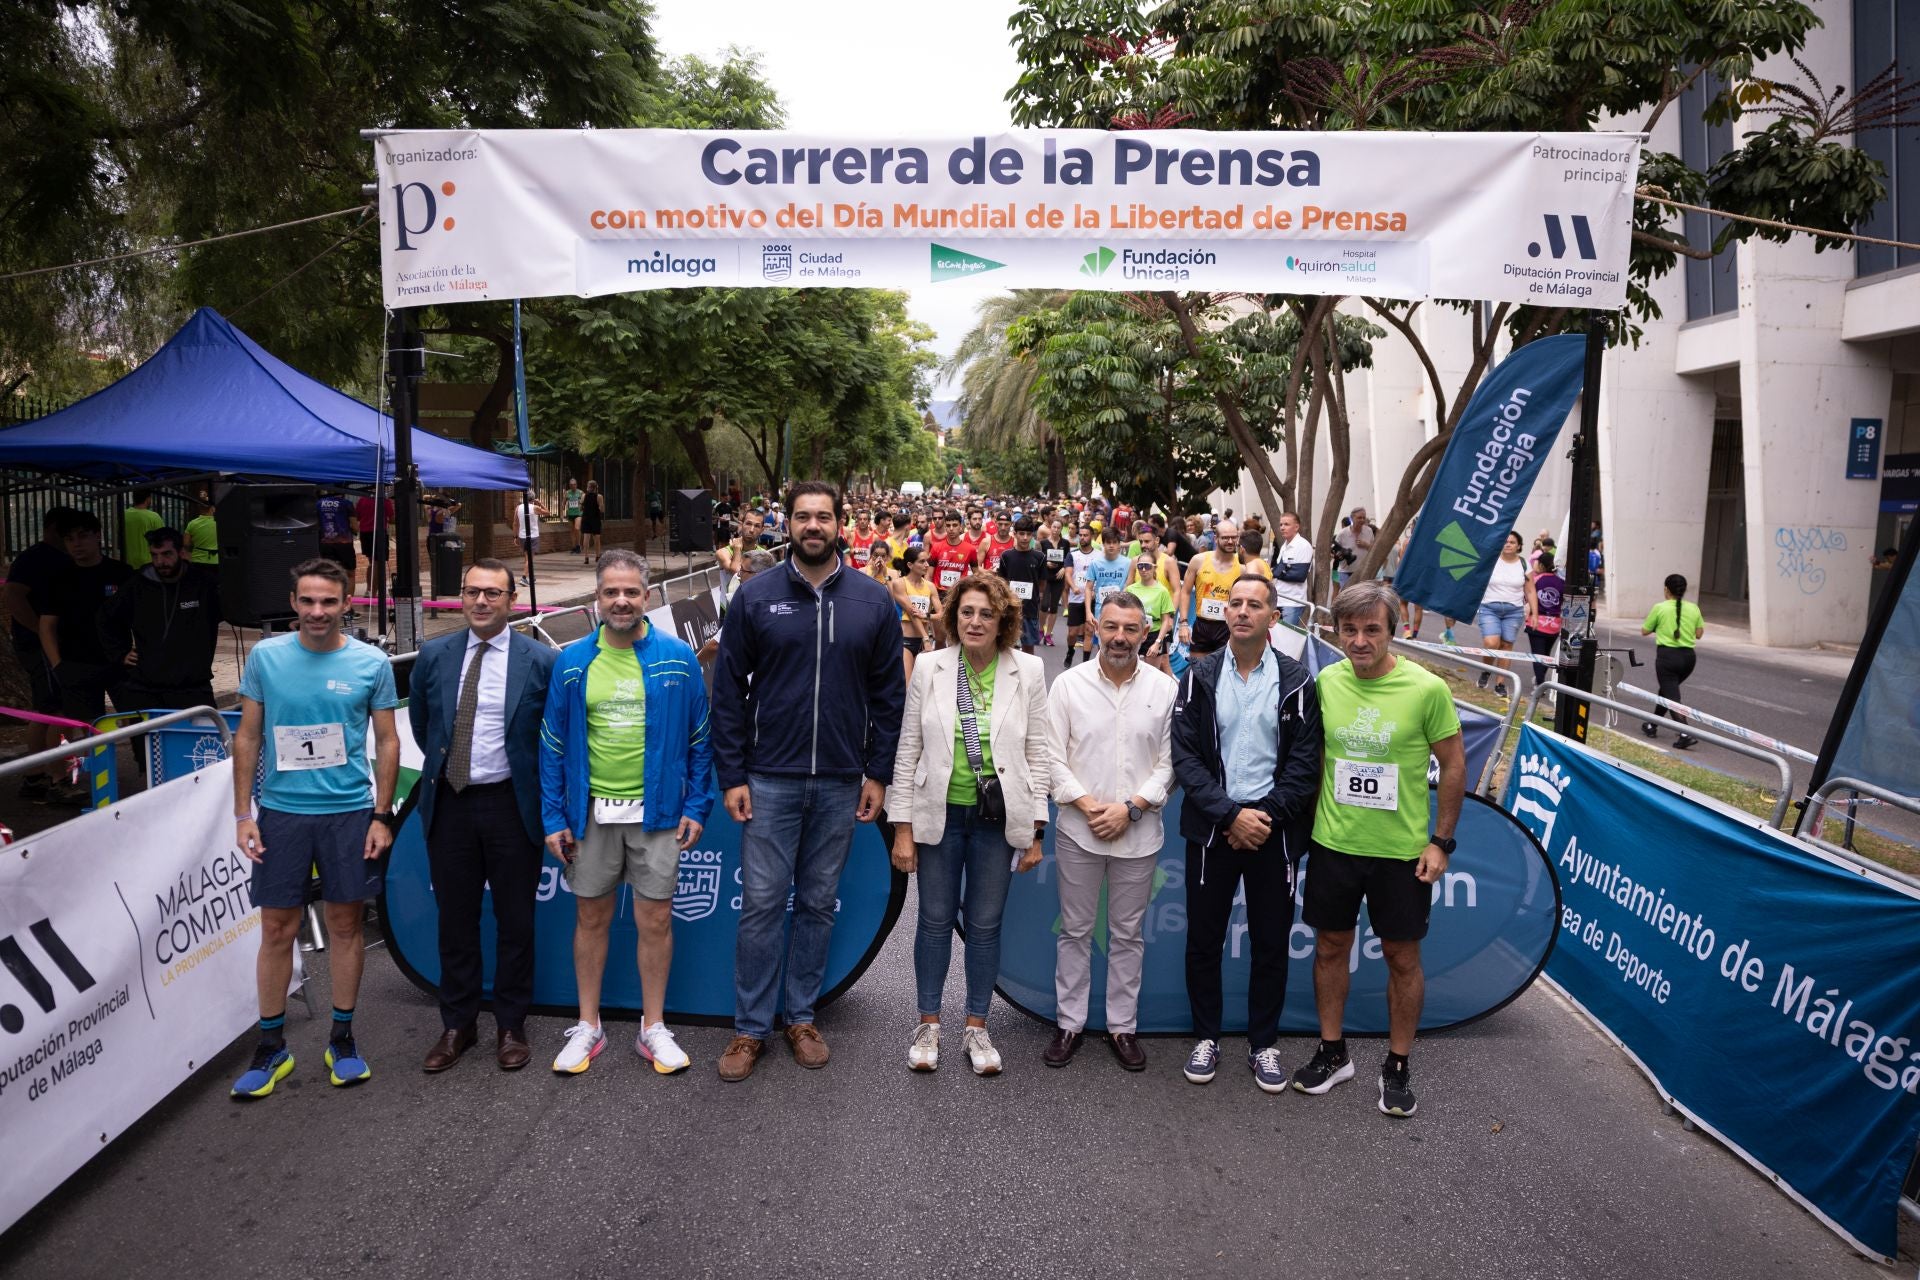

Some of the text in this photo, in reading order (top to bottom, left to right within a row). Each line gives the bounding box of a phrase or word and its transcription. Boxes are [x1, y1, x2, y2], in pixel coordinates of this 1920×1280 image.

[386, 148, 478, 165] Organizadora:
[701, 137, 1321, 187] Carrera de la Prensa
[1533, 145, 1631, 163] Patrocinadora
[1564, 167, 1628, 184] principal:
[590, 201, 1407, 232] con motivo del Día Mundial de la Libertad de Prensa
[799, 253, 842, 264] Ciudad
[1122, 248, 1216, 265] Fundación
[1343, 250, 1377, 260] Hospital
[396, 265, 476, 282] Asociación de la
[799, 265, 861, 278] de Málaga
[1123, 266, 1190, 282] Unicaja
[1299, 260, 1376, 275] quirónsalud
[1504, 264, 1619, 283] Diputación Provincial
[398, 279, 488, 297] Prensa de Málaga
[1346, 275, 1377, 284] Málaga
[1529, 281, 1593, 296] de Málaga
[1856, 426, 1876, 439] P8
[1453, 387, 1532, 517] Fundación
[1475, 433, 1537, 525] Unicaja
[1099, 570, 1123, 579] nerja
[1207, 605, 1220, 614] 33
[301, 741, 314, 756] 1
[1349, 776, 1378, 794] 80
[156, 851, 246, 924] MÁLAGA
[175, 937, 224, 976] PROVINCIA
[1560, 835, 1920, 1095] Ayuntamiento de Málaga
[1583, 919, 1604, 951] de
[1605, 931, 1671, 1004] Deporte
[68, 984, 130, 1042] Provincial
[28, 1037, 103, 1101] de Málaga
